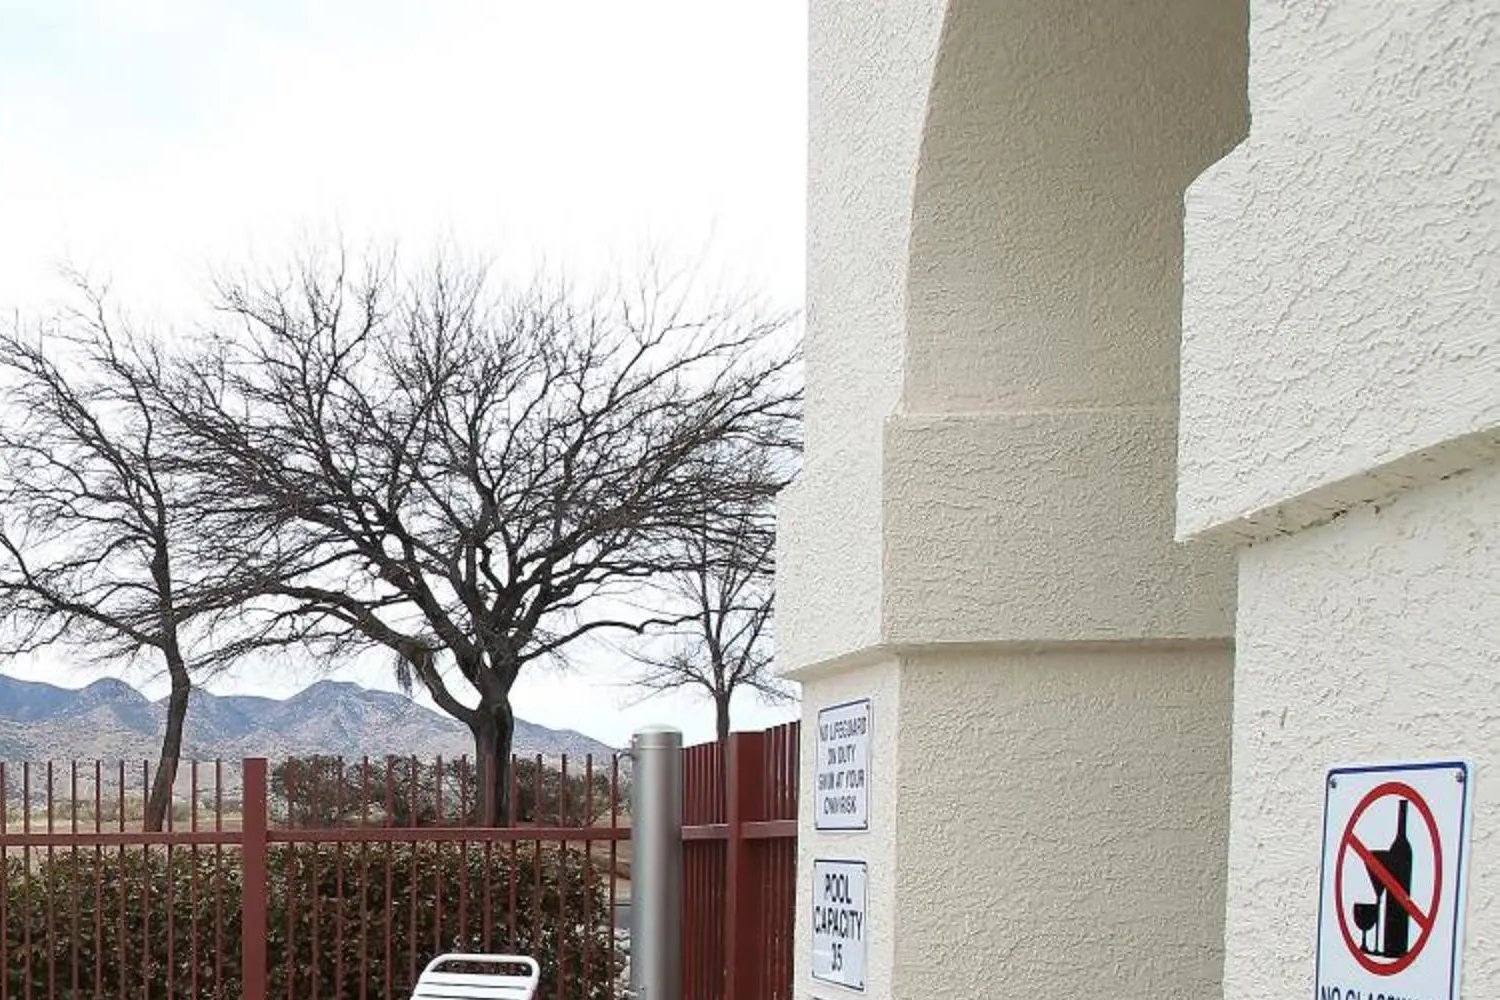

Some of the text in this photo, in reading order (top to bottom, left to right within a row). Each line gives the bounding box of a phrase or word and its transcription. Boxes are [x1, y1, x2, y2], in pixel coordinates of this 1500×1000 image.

[838, 744, 856, 764] DUTY
[845, 770, 865, 789] YOUR
[824, 873, 852, 904] POOL
[814, 906, 863, 941] CAPACITY
